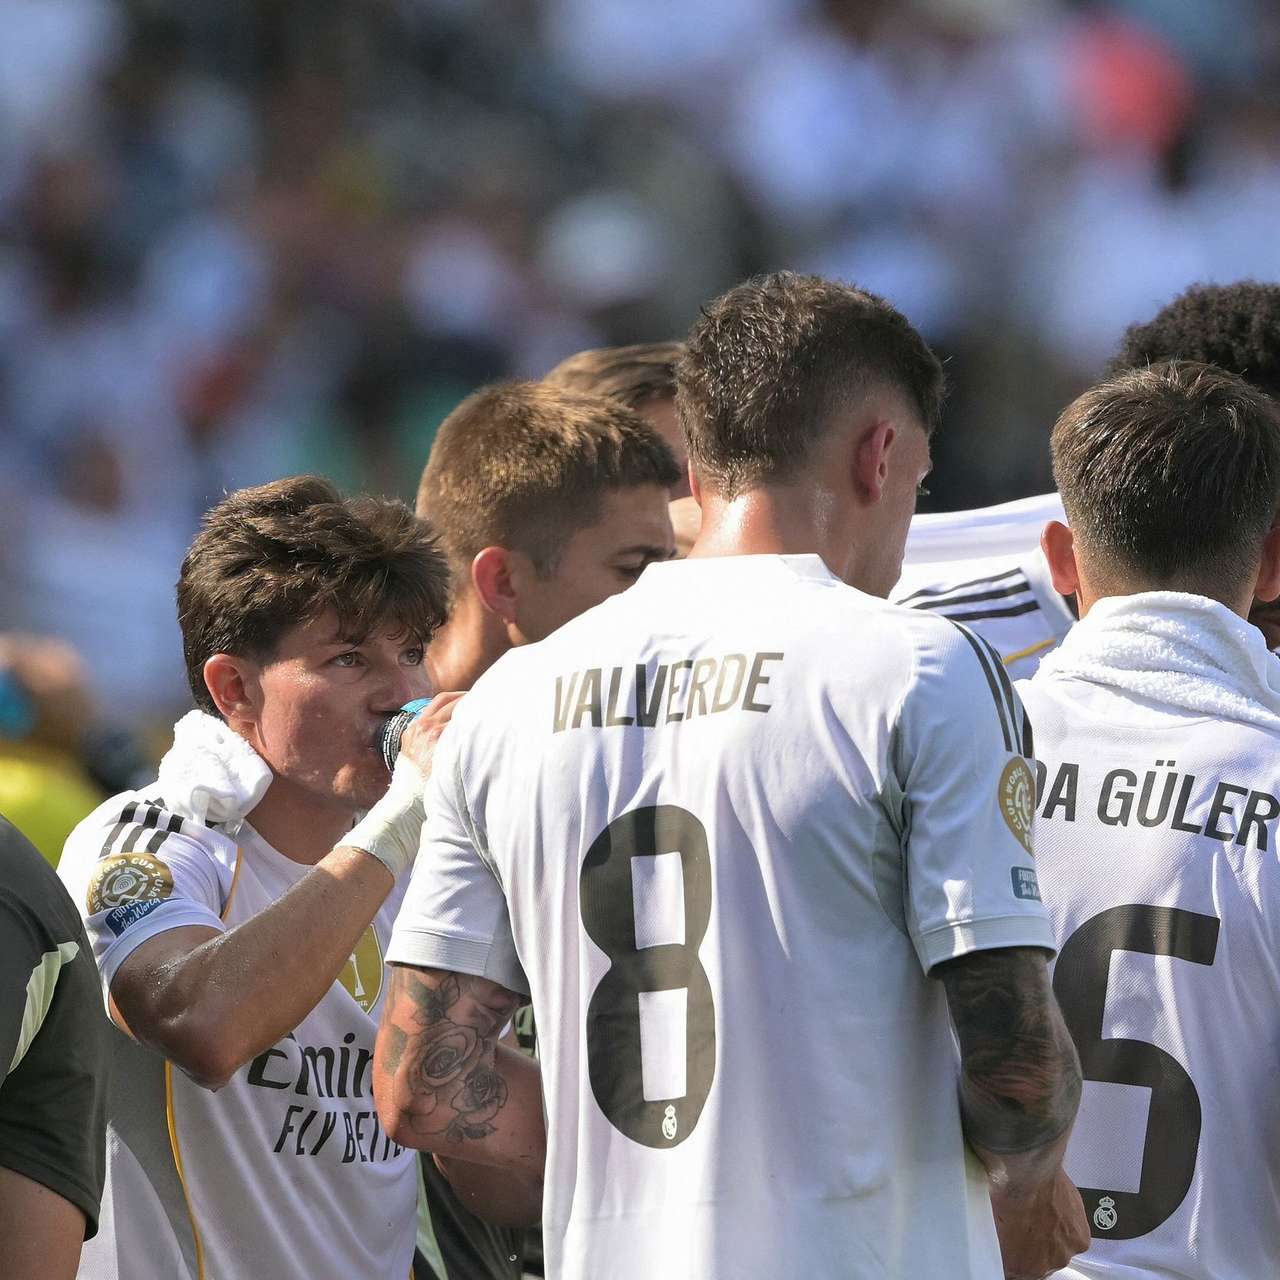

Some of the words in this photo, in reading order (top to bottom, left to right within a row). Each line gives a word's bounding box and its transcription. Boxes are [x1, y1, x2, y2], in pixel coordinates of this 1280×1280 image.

[553, 652, 783, 734] VALVERDE
[1097, 760, 1280, 852] GÜLER
[580, 805, 715, 1149] 8
[248, 1031, 374, 1098] Emir
[1053, 903, 1220, 1241] 5
[273, 1105, 337, 1157] FLY
